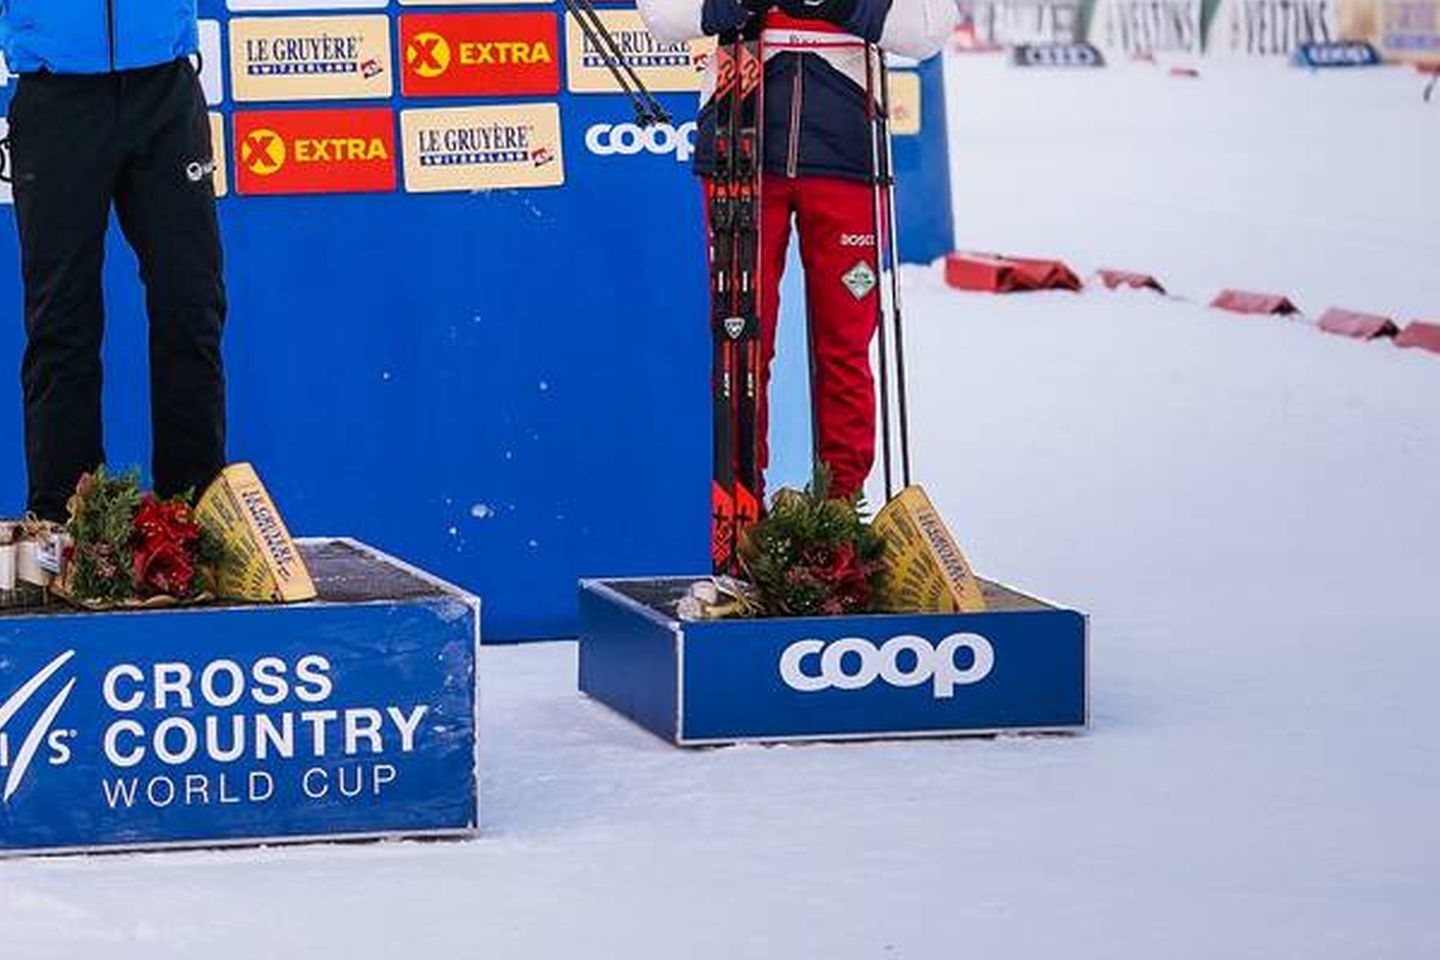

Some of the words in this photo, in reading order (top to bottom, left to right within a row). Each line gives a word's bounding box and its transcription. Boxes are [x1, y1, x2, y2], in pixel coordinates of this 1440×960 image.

[247, 41, 270, 62] LE
[273, 34, 358, 61] GRUYÈRE
[460, 42, 551, 64] EXTRA
[248, 63, 357, 75] SWITZERLAND
[295, 139, 387, 162] EXTRA
[419, 129, 441, 152] LE
[444, 122, 529, 150] GRUYÈRE
[420, 152, 528, 166] SWITZERLAND
[779, 632, 994, 698] coop
[103, 655, 331, 712] CROSS
[104, 706, 427, 767] COUNTRY
[103, 773, 274, 808] WORLD
[304, 766, 398, 798] CUP
